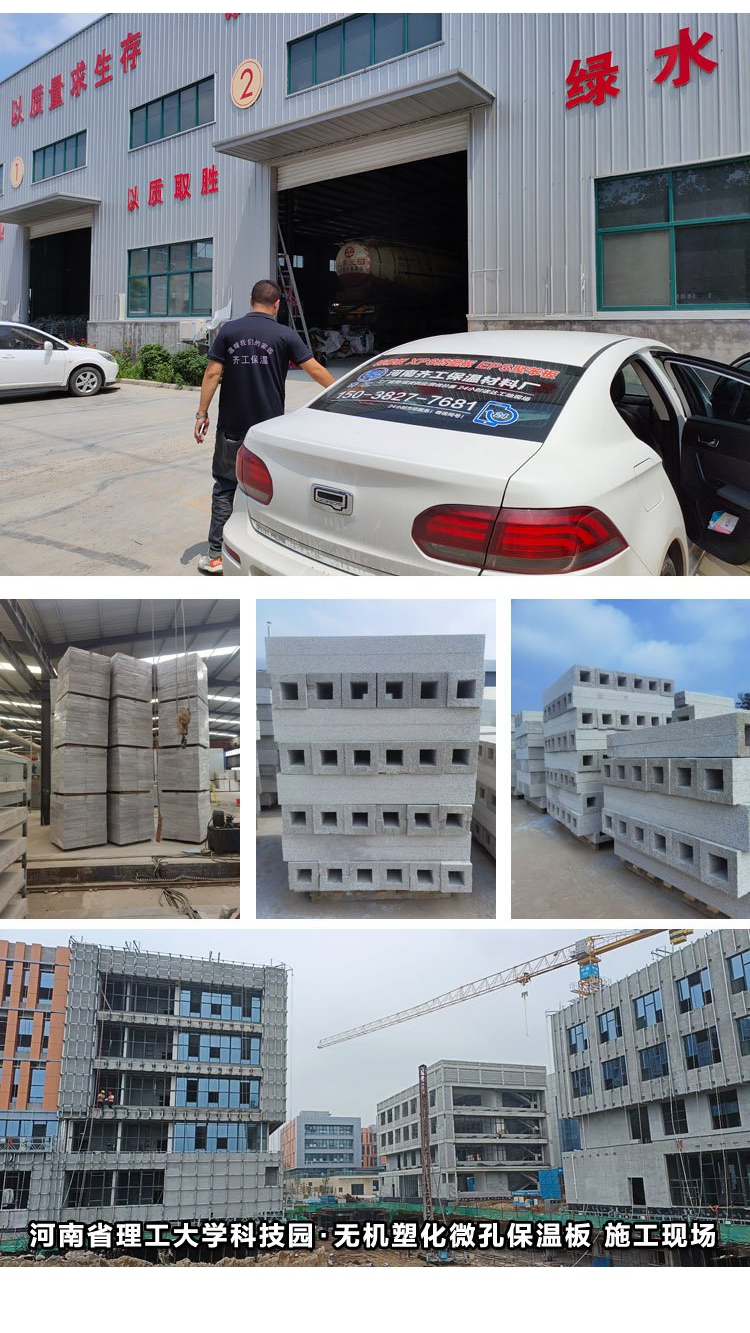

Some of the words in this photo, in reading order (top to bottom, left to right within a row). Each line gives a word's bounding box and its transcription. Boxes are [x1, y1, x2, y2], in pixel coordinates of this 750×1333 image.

[11, 31, 142, 127] 以质量求生存
[240, 68, 253, 100] 2
[565, 27, 719, 110] 绿水
[127, 164, 219, 212] 以质取胜
[232, 355, 269, 365] 齐工保温
[385, 369, 541, 390] 河南齐工保温材料厂
[336, 390, 478, 412] 150-3827-7681
